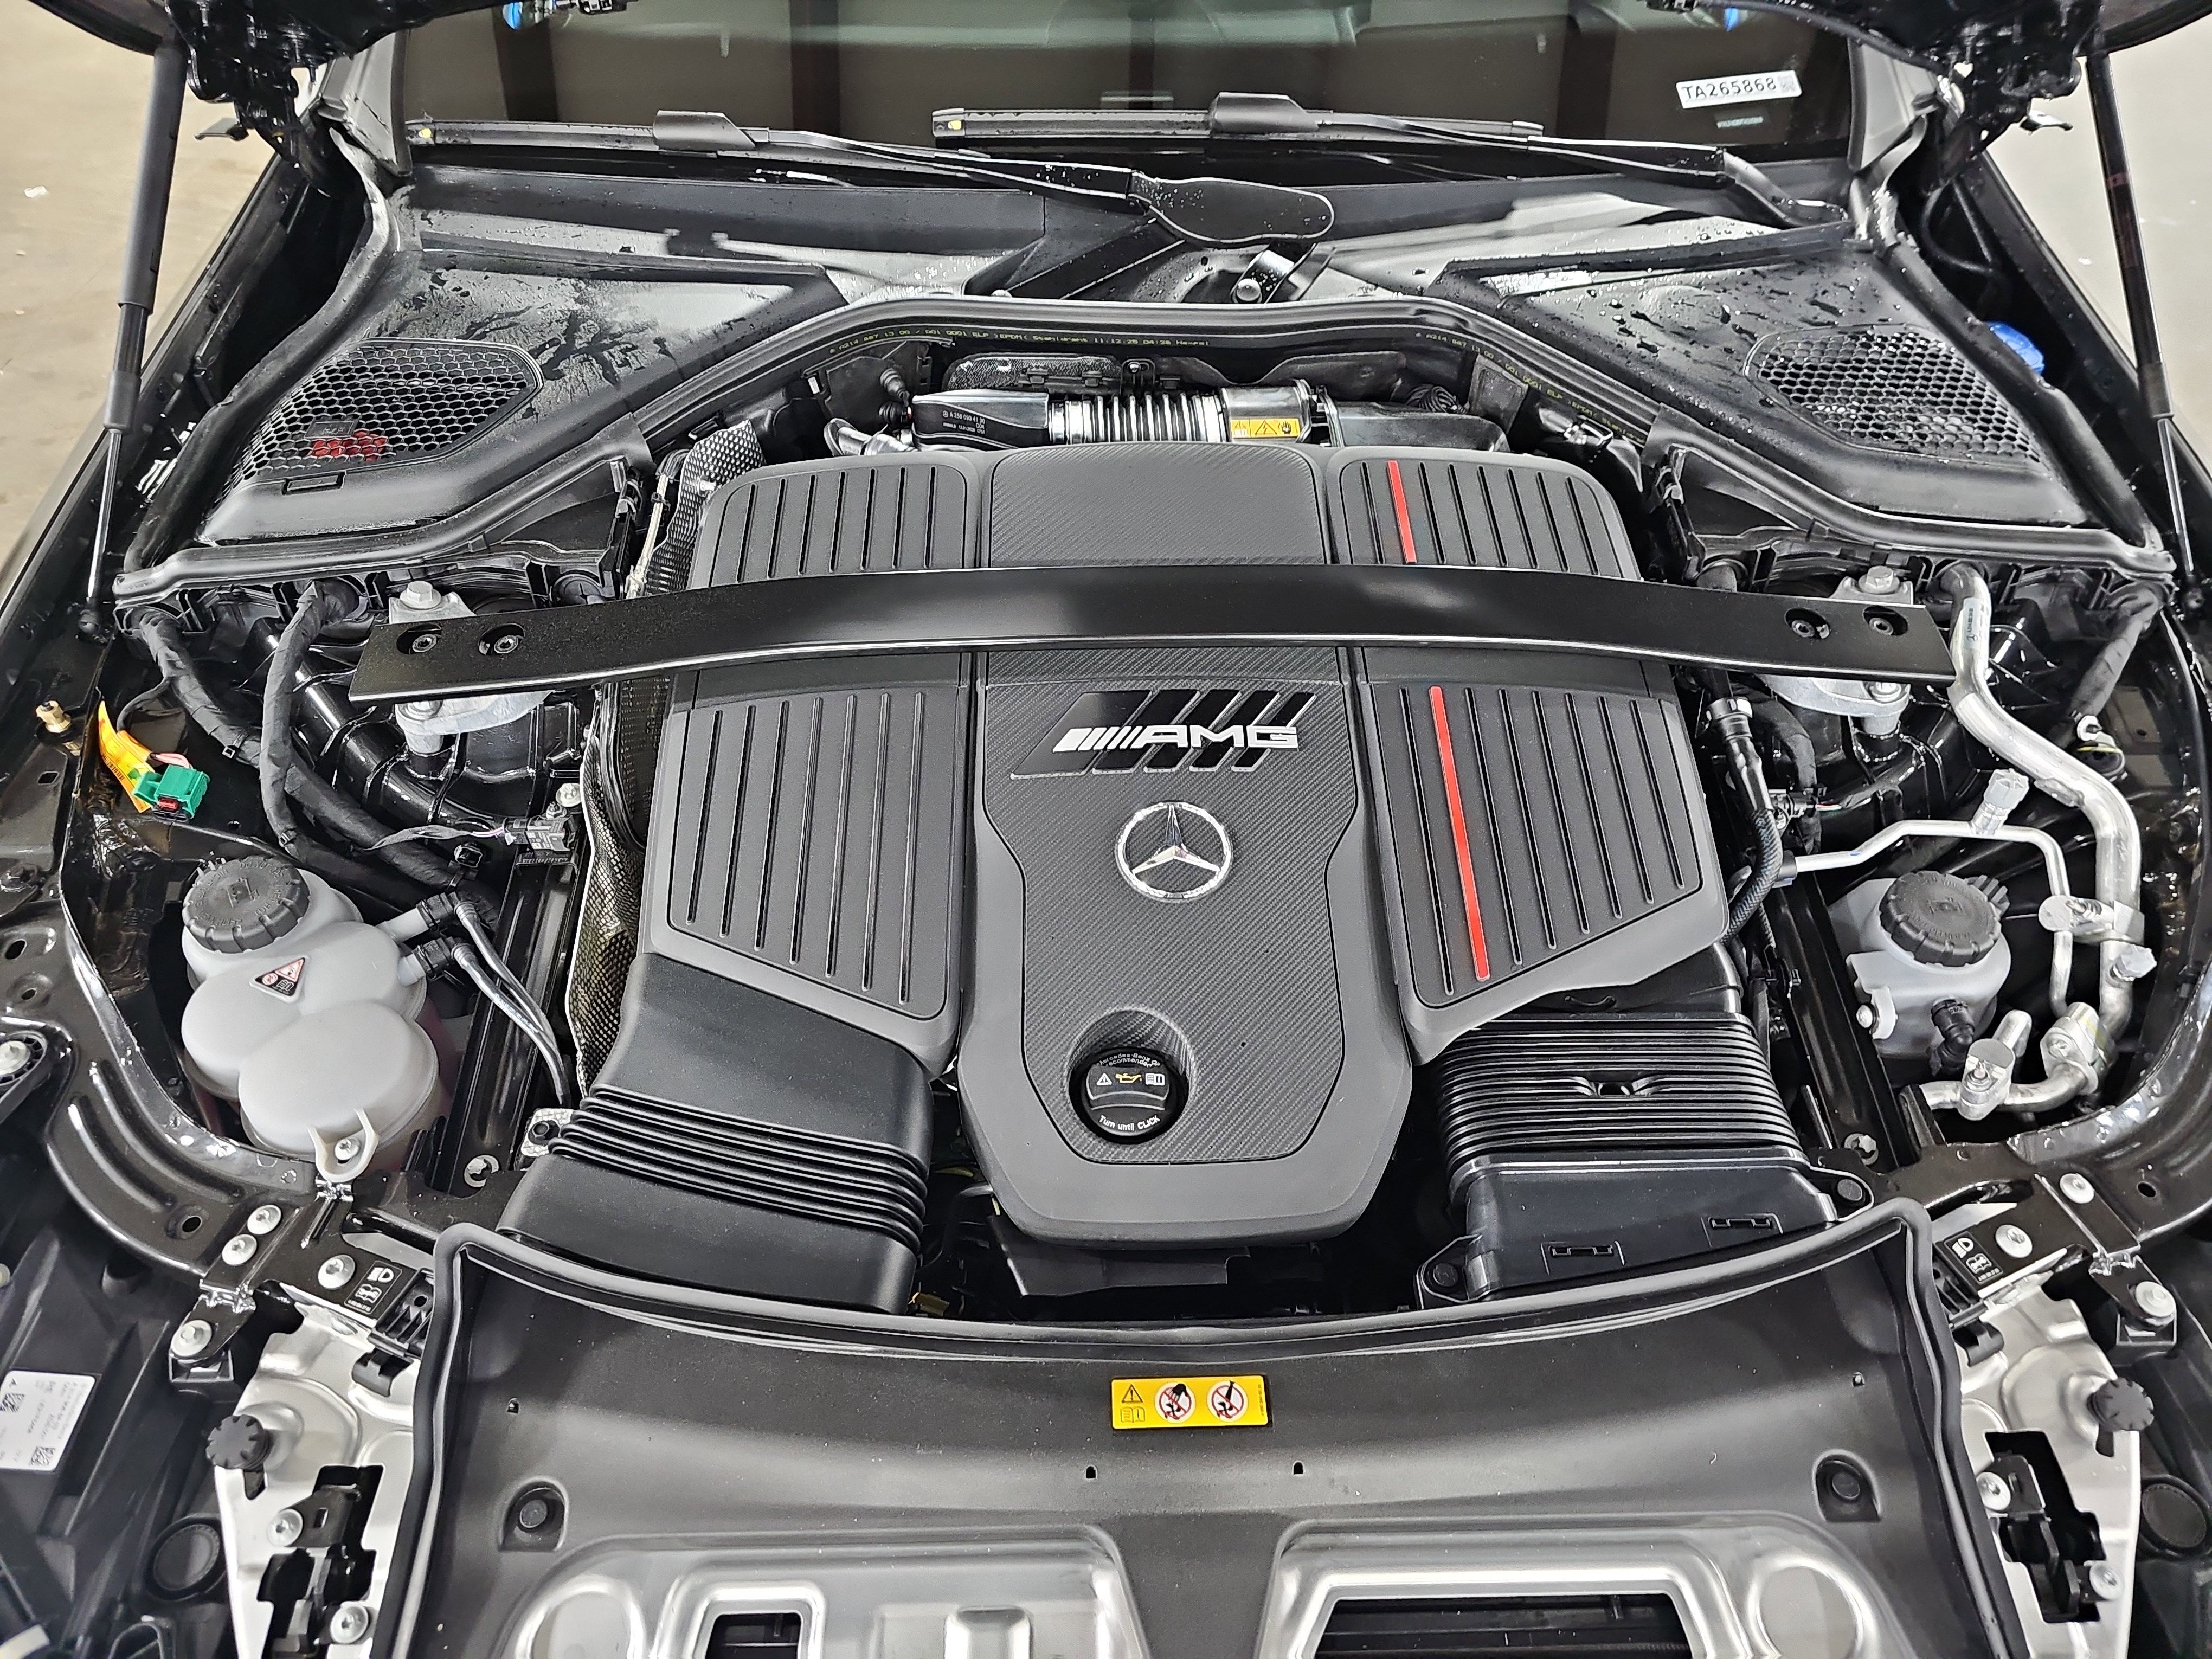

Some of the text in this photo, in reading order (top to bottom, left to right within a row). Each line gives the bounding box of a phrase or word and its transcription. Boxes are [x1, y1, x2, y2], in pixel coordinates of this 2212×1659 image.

[1681, 77, 1777, 99] TA265868
[1130, 725, 1298, 750] AMG
[1099, 1115, 1160, 1131] Turn until CLICK
